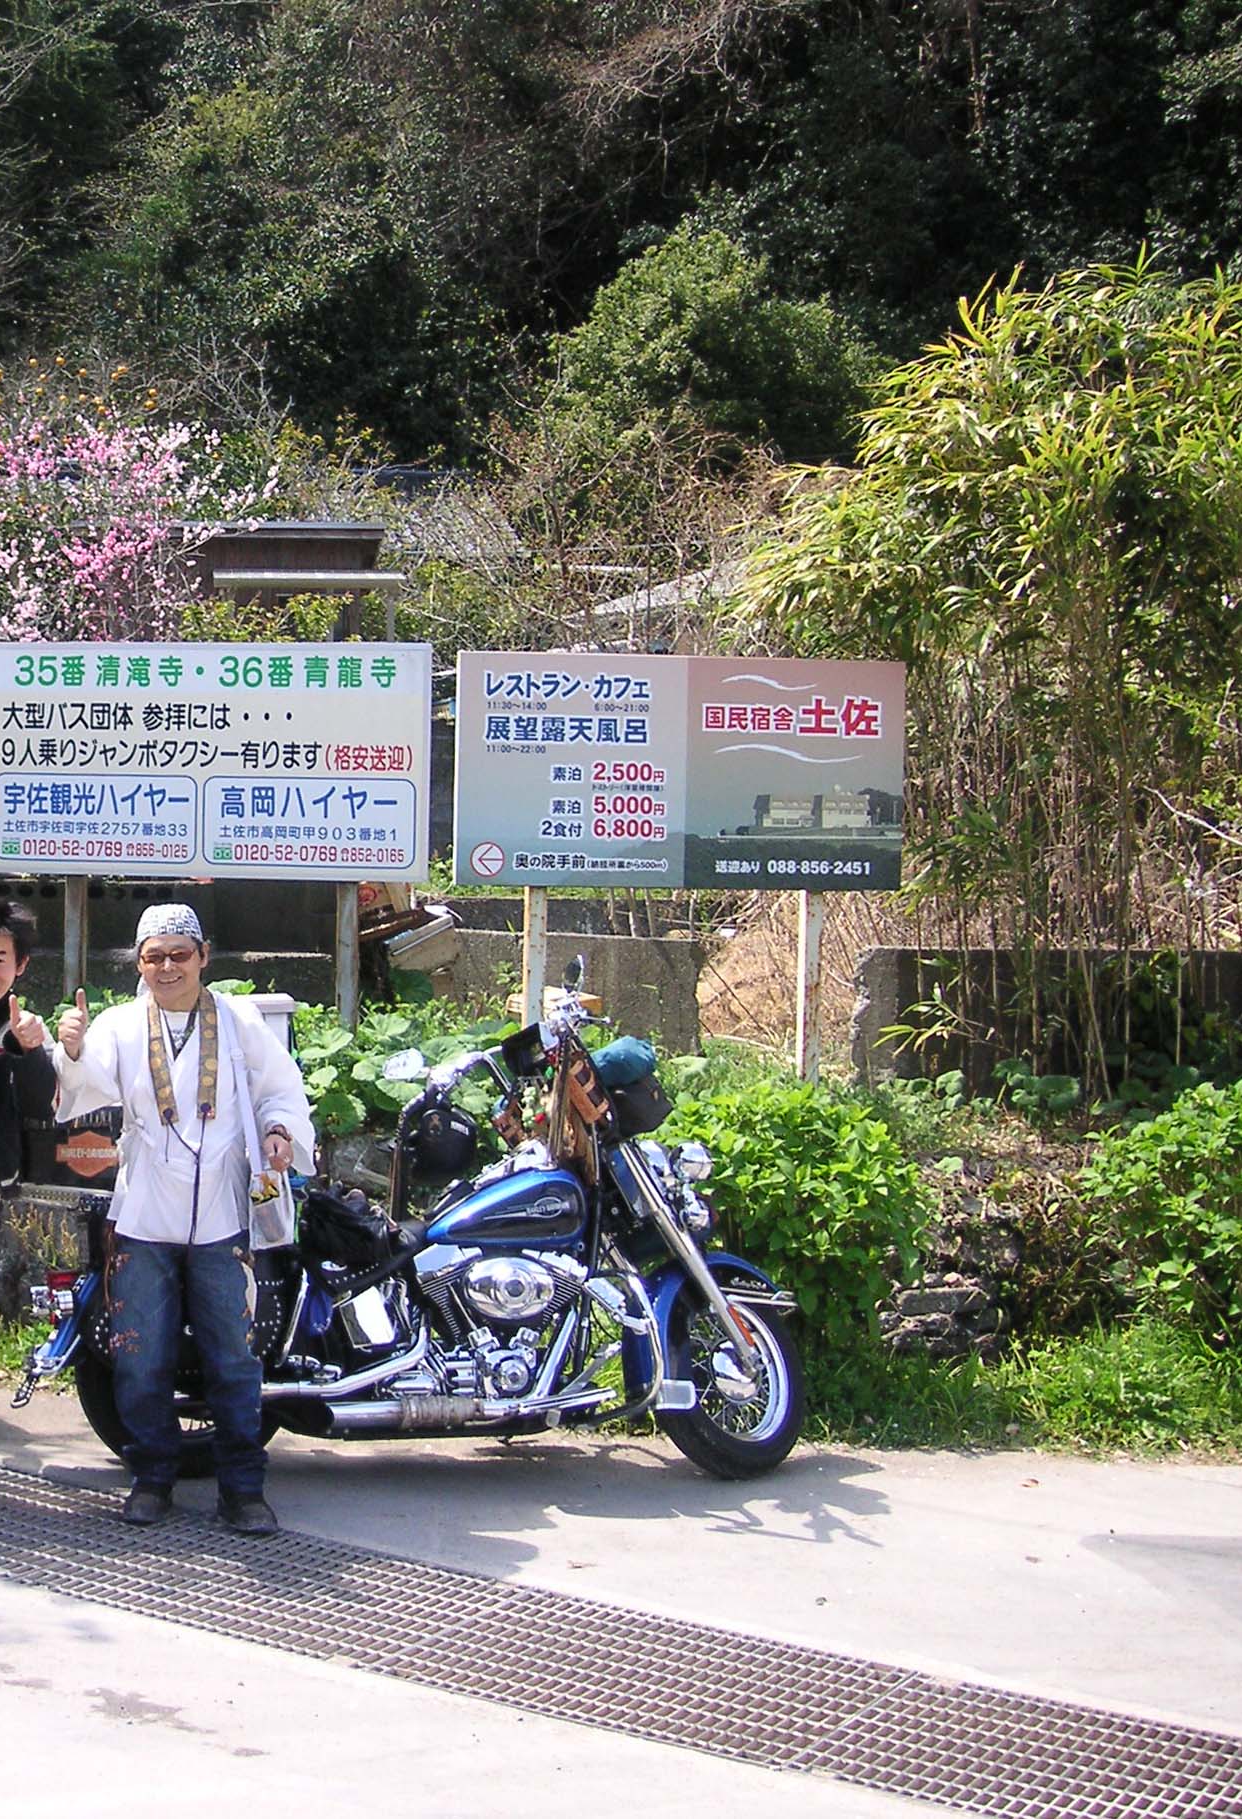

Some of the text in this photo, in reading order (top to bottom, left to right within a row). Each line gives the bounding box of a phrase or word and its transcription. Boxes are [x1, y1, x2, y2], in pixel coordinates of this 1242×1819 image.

[485, 672, 650, 700] レストラン・カフェ
[704, 698, 880, 737] 国民宿舎 土佐
[485, 715, 648, 744] 展望露天風呂
[552, 762, 665, 783] 素泊 2,500円
[3, 782, 190, 817] 宇佐観光ハイヤー
[221, 785, 398, 820] 高岡ハイヤー
[552, 796, 665, 816] 素泊 5,000円
[3, 820, 188, 837] 土佐市宇佐町宇佐2757番地33
[219, 825, 398, 842] 土佐市高岡町甲903番地1
[541, 818, 665, 839] 2食付 6,800円
[23, 839, 123, 858] 0120-52-0769
[234, 844, 337, 862] 0120-52-0769
